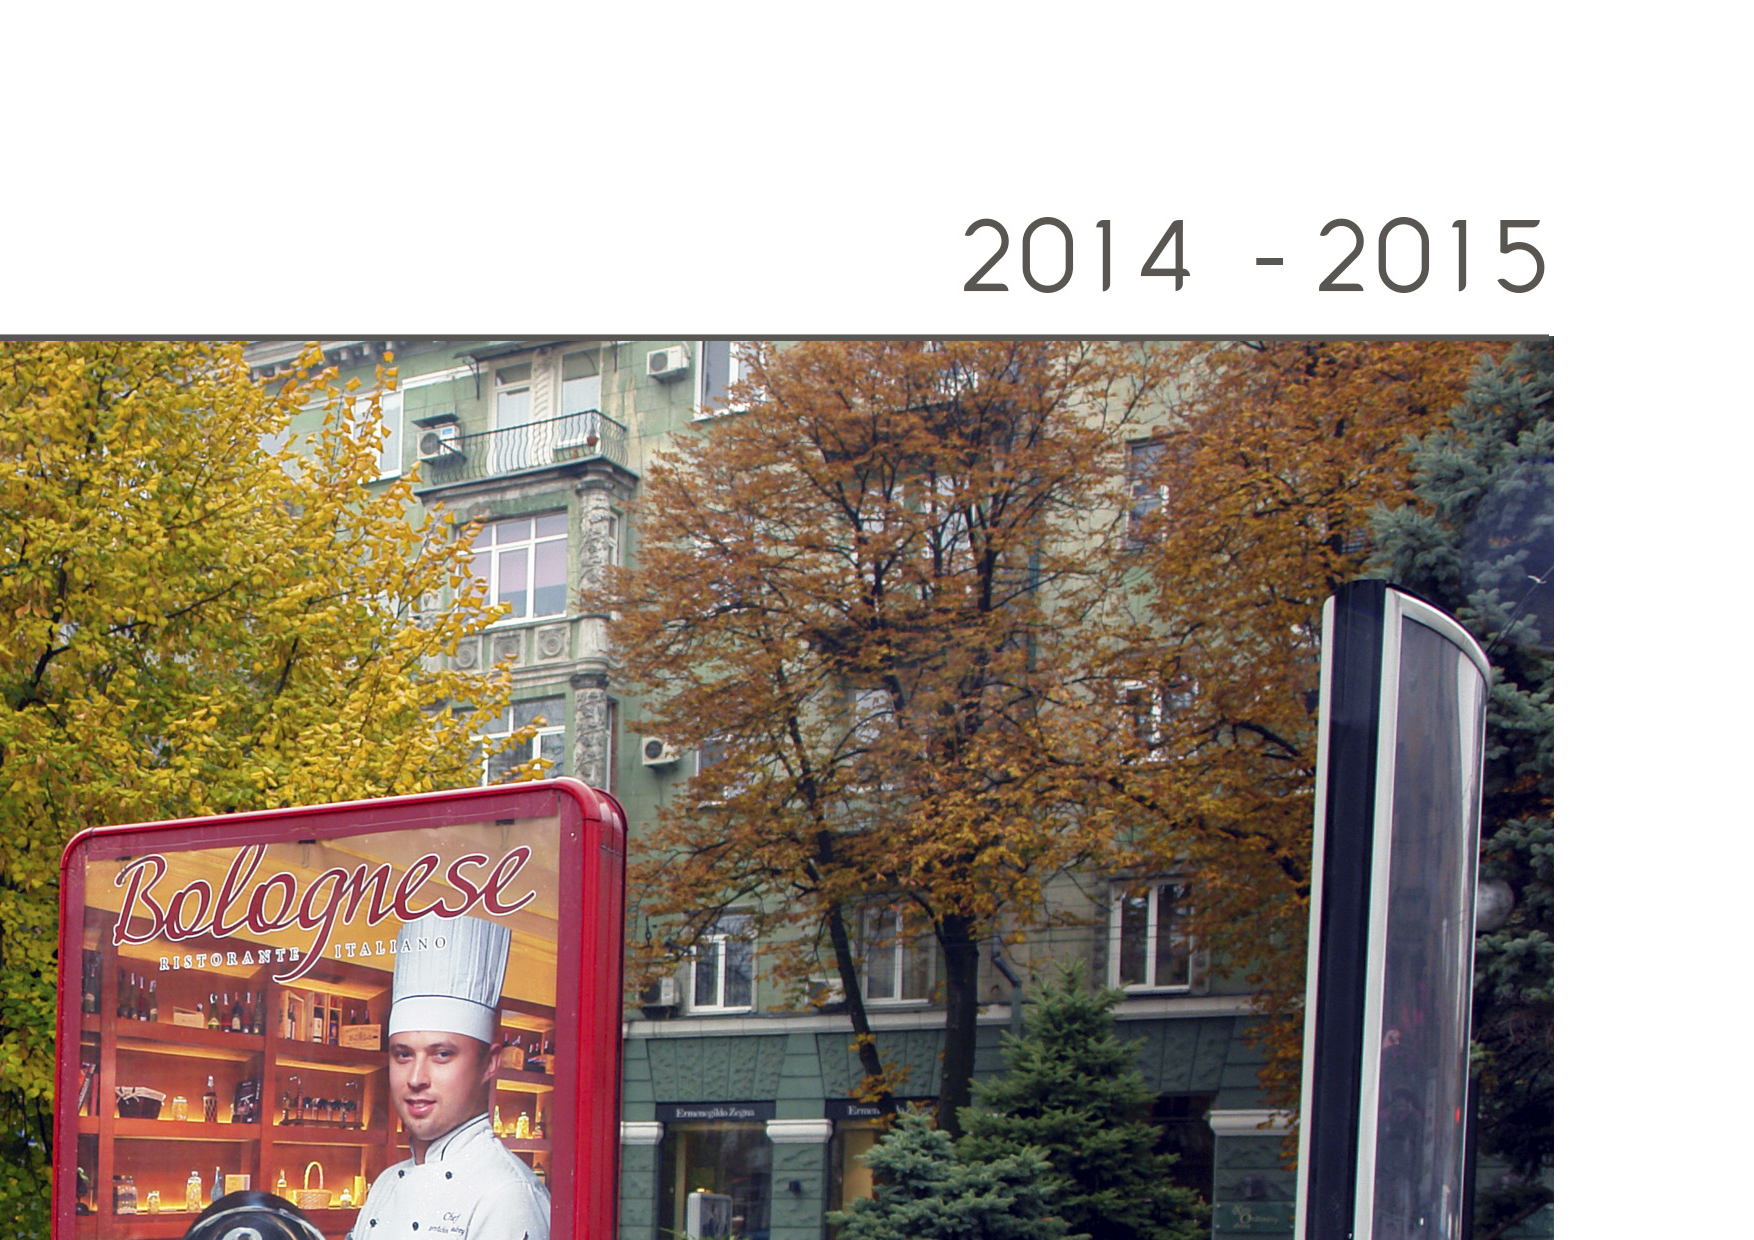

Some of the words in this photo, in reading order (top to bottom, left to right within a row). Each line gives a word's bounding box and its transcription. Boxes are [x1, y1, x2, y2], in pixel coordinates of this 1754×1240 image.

[113, 844, 537, 983] Bolognese
[159, 947, 300, 971] RISTORANTE
[335, 936, 447, 959] ITALIANO
